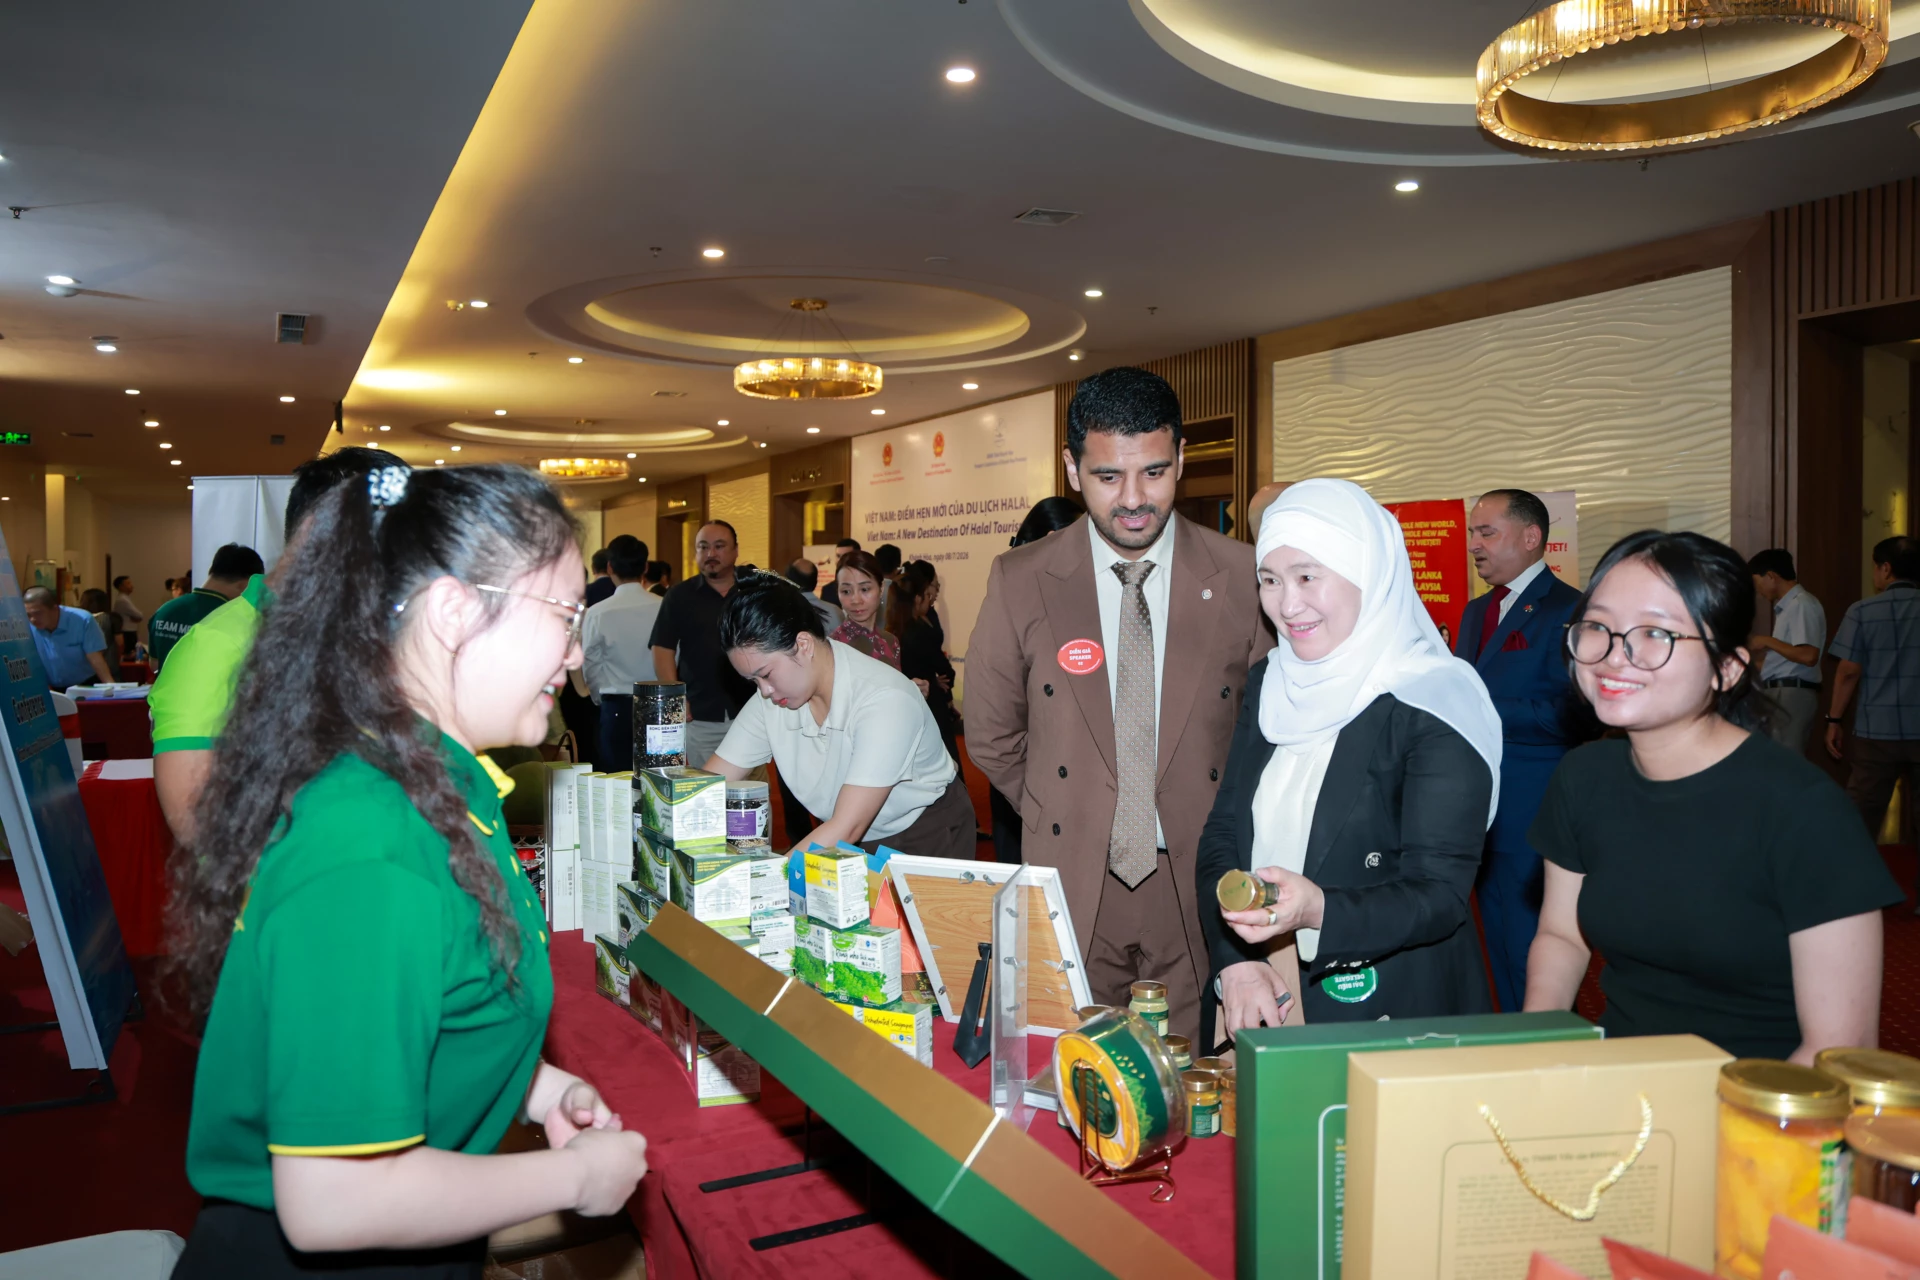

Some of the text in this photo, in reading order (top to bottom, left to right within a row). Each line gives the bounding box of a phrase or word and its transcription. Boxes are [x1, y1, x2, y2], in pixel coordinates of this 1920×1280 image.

[966, 502, 978, 515] DU
[980, 499, 999, 517] LỊCH
[1000, 496, 1031, 511] HALAL
[1431, 520, 1457, 528] WORLD,
[897, 528, 902, 540] A
[902, 528, 917, 540] New
[917, 524, 958, 539] Destination
[959, 522, 970, 537] Of
[970, 520, 992, 536] Halal
[993, 519, 1022, 534] Touris
[1422, 530, 1437, 538] NEW
[1545, 542, 1568, 553] TJET!
[1411, 560, 1427, 568] DIA
[1416, 571, 1443, 580] LANKA
[1415, 582, 1442, 591] LAYSIA
[1421, 594, 1450, 603] IPPINES
[155, 620, 178, 633] TEAM
[1334, 974, 1365, 983] DELEGATE
[864, 1015, 890, 1027] Dehydrated
